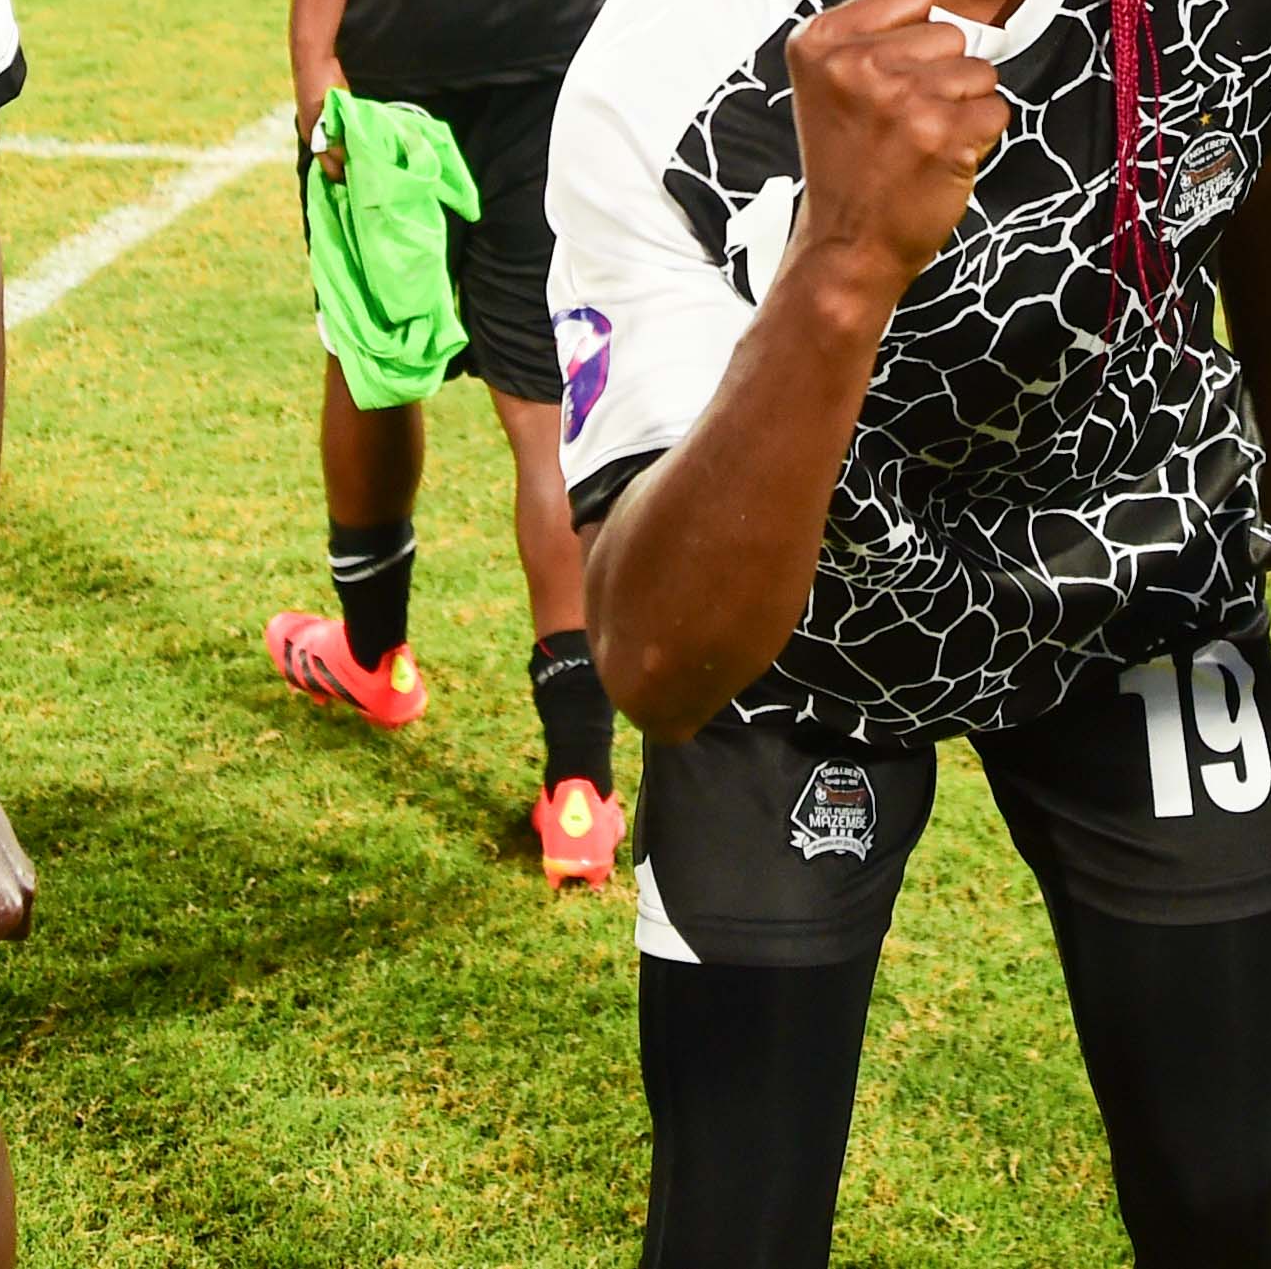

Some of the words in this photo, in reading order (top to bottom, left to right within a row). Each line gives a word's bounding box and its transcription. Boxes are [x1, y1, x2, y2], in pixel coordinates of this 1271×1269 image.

[1175, 172, 1235, 218] MAZEMBE
[1119, 639, 1271, 819] 19
[808, 813, 868, 829] MAZEMBE
